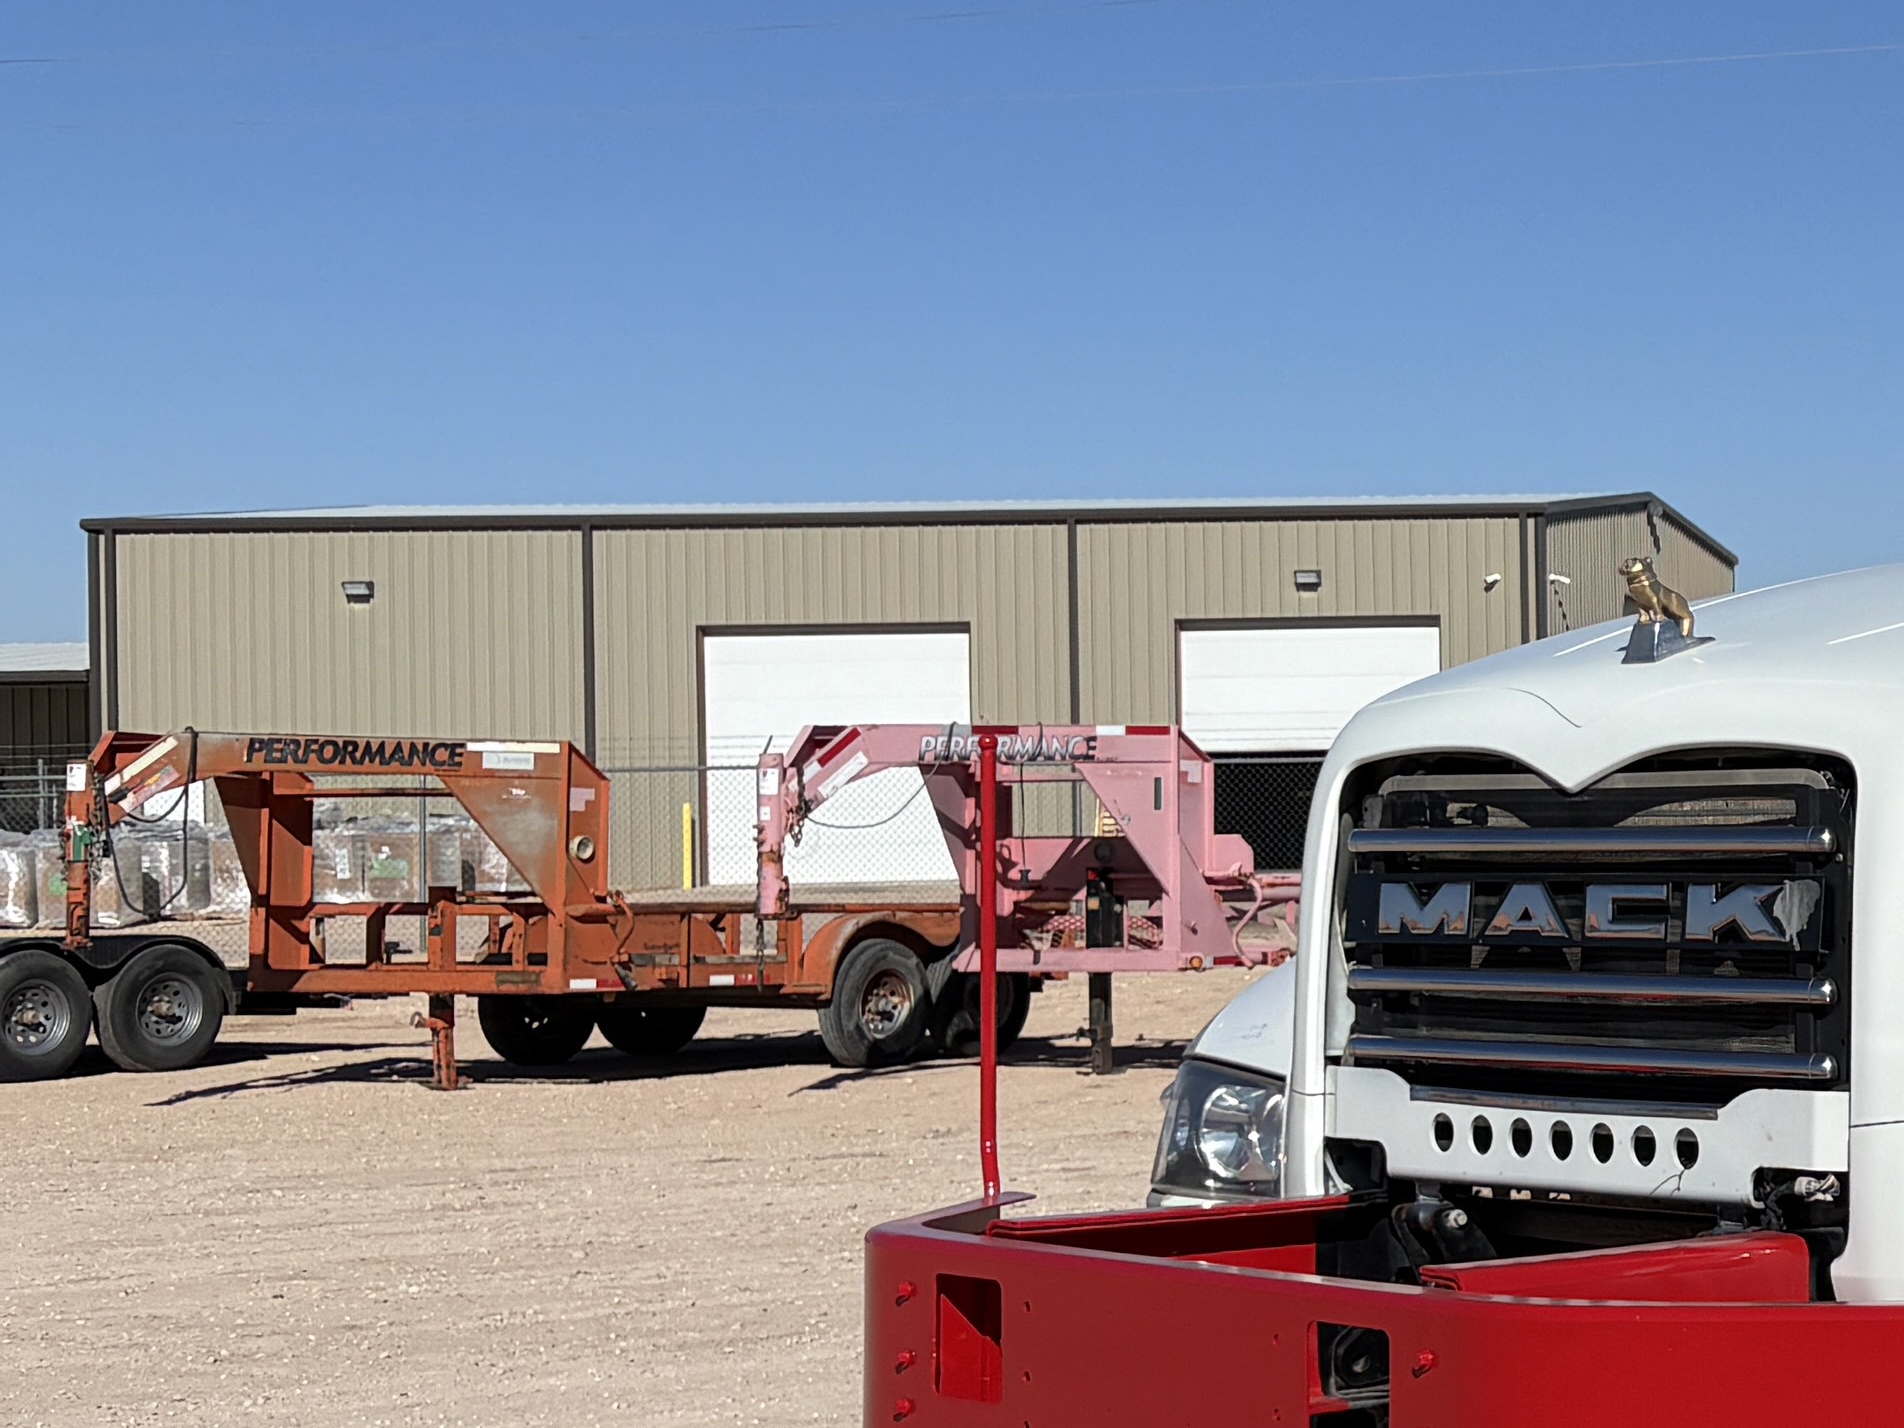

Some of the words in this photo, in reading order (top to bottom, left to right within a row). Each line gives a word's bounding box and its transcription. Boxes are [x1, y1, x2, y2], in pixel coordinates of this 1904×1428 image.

[244, 737, 467, 768] PERFORMANCE
[919, 735, 1097, 761] PERFRMANCE
[1378, 881, 1790, 942] MACK
